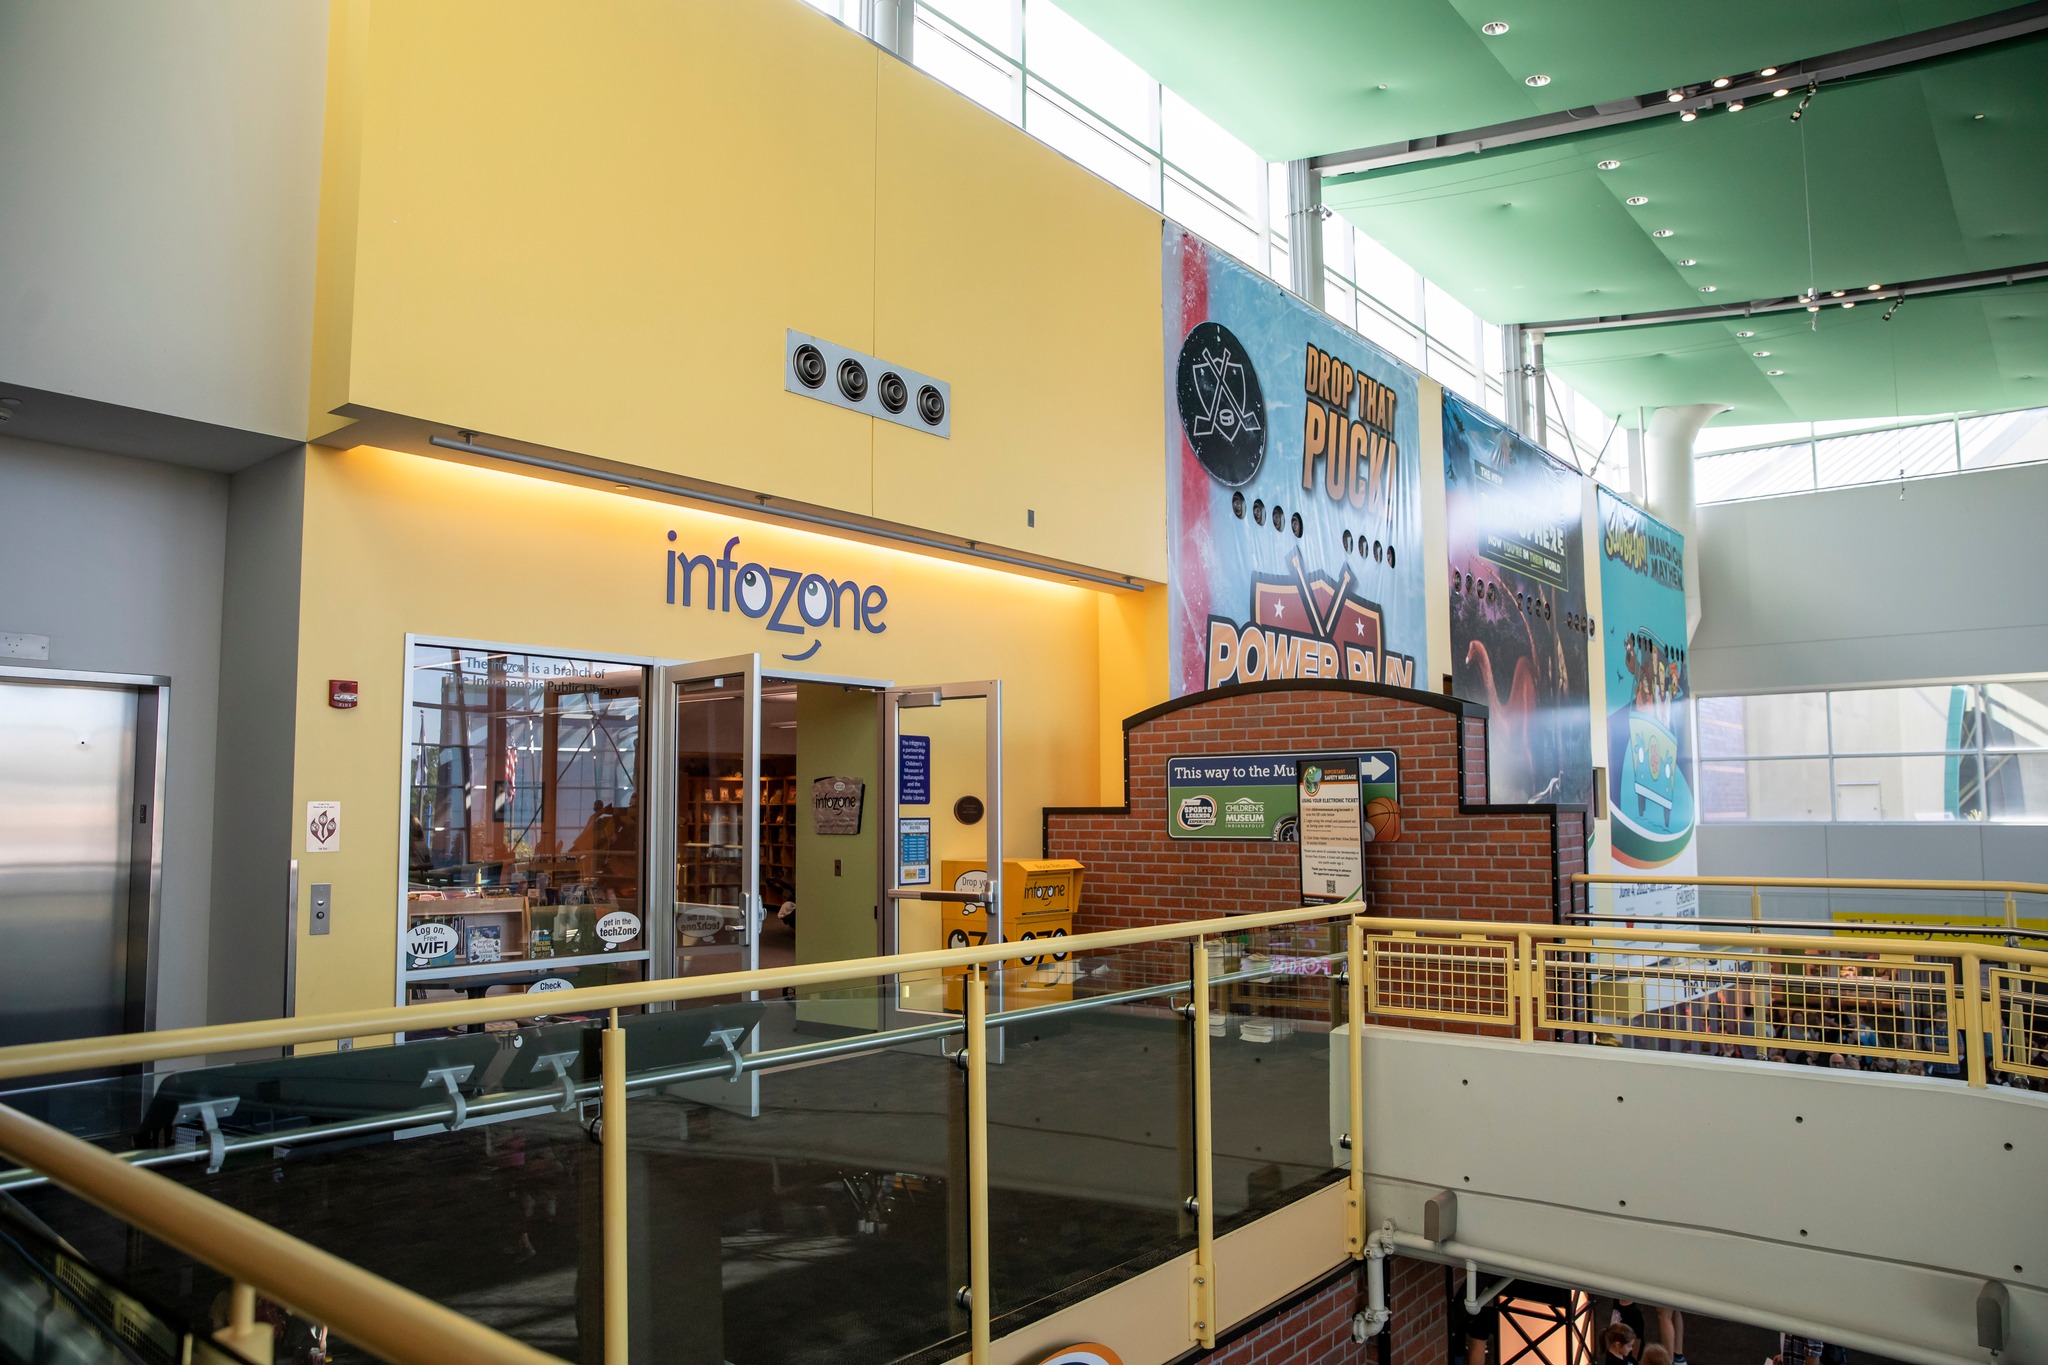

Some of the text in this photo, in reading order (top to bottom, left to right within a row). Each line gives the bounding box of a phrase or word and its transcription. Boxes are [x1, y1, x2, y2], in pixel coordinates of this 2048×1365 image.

[1305, 342, 1397, 435] DROP THAT
[1302, 397, 1398, 526] PUCK!
[1480, 466, 1491, 480] THE
[1487, 533, 1561, 575] NOW YOU'RE IN THEIR WORLD
[666, 529, 888, 635] infozone
[1650, 558, 1684, 592] MAYHEM
[1209, 620, 1340, 690] POWER
[465, 656, 488, 669] The
[531, 662, 540, 674] is
[543, 666, 550, 675] a
[553, 664, 591, 678] branch
[594, 668, 606, 679] of
[445, 672, 621, 697] The Indianapolis Public Library
[1174, 766, 1202, 779] This
[1204, 768, 1230, 781] way
[1232, 766, 1246, 778] to
[1249, 765, 1270, 777] the
[815, 793, 856, 811] infozone
[1225, 804, 1265, 812] CHILDREN'S
[1225, 814, 1265, 822] MUSEUM
[962, 876, 978, 888] Drop
[1024, 881, 1066, 900] infozone
[1619, 885, 1631, 899] June
[603, 917, 632, 928] get in the
[415, 926, 431, 937] Log
[600, 927, 638, 938] techZone
[411, 941, 448, 955] WIFI
[540, 981, 562, 991] Check
